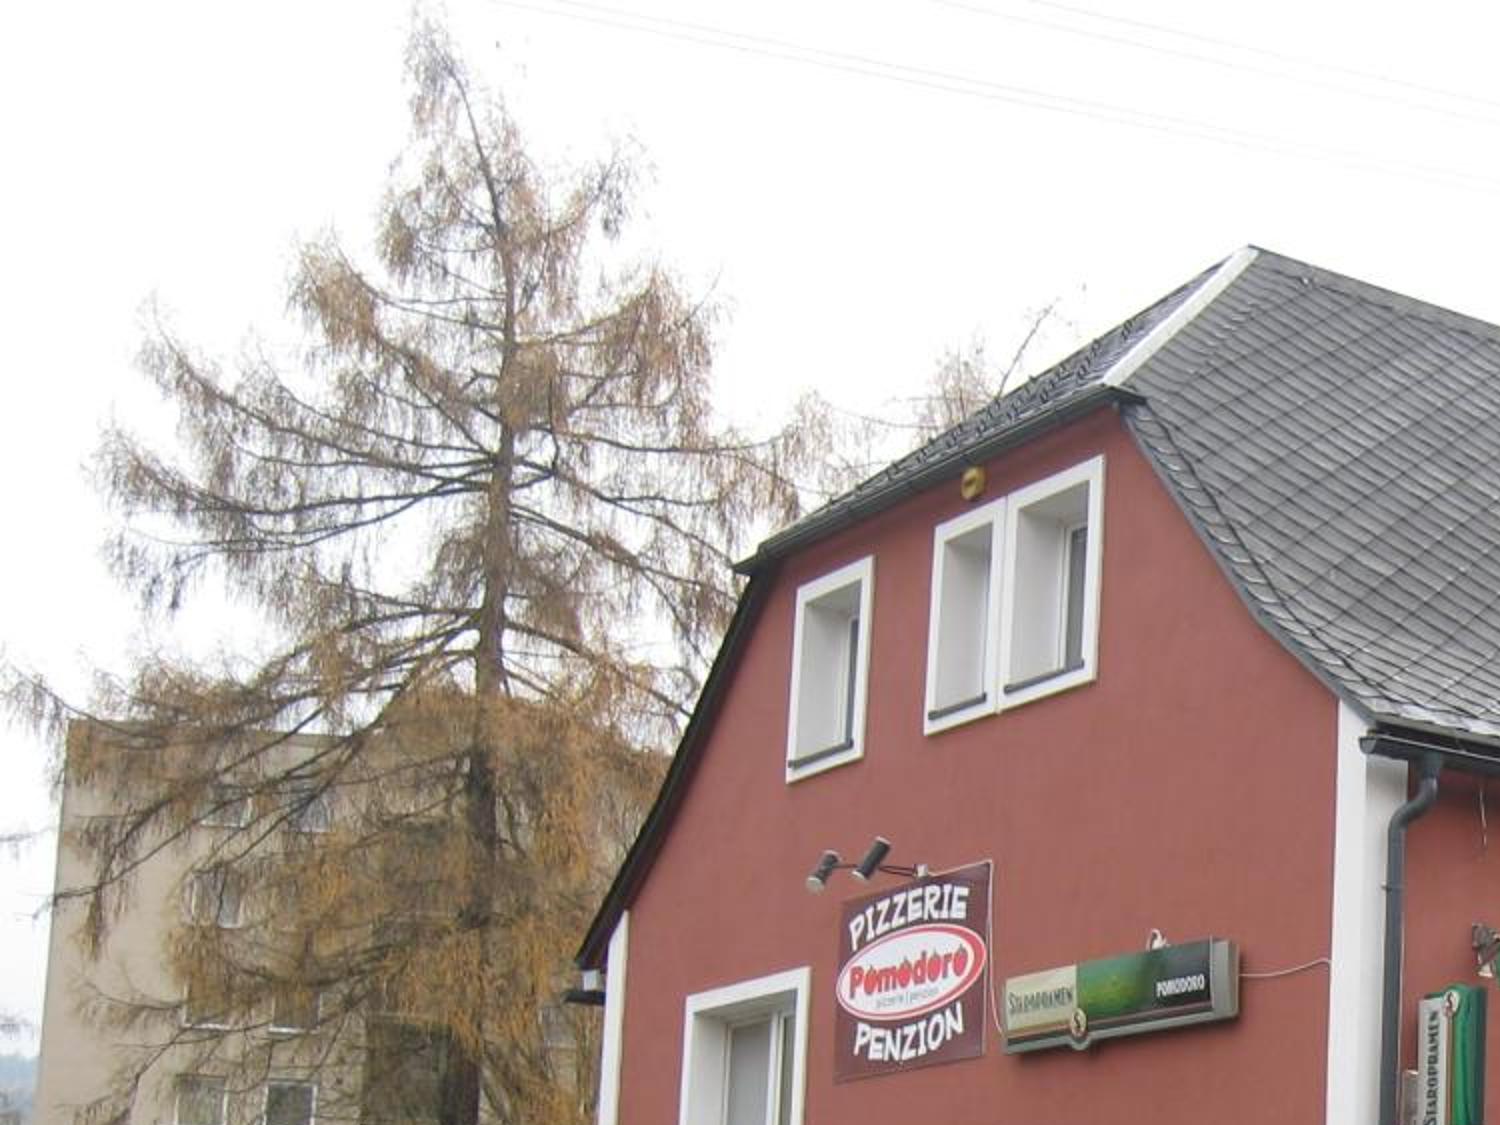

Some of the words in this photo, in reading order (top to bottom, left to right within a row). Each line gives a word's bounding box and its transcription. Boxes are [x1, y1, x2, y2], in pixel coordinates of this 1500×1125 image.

[849, 883, 969, 951] PIZZERIE
[849, 945, 969, 999] Pomodoro
[1156, 973, 1206, 997] POMODORO
[853, 1001, 964, 1061] PENZION
